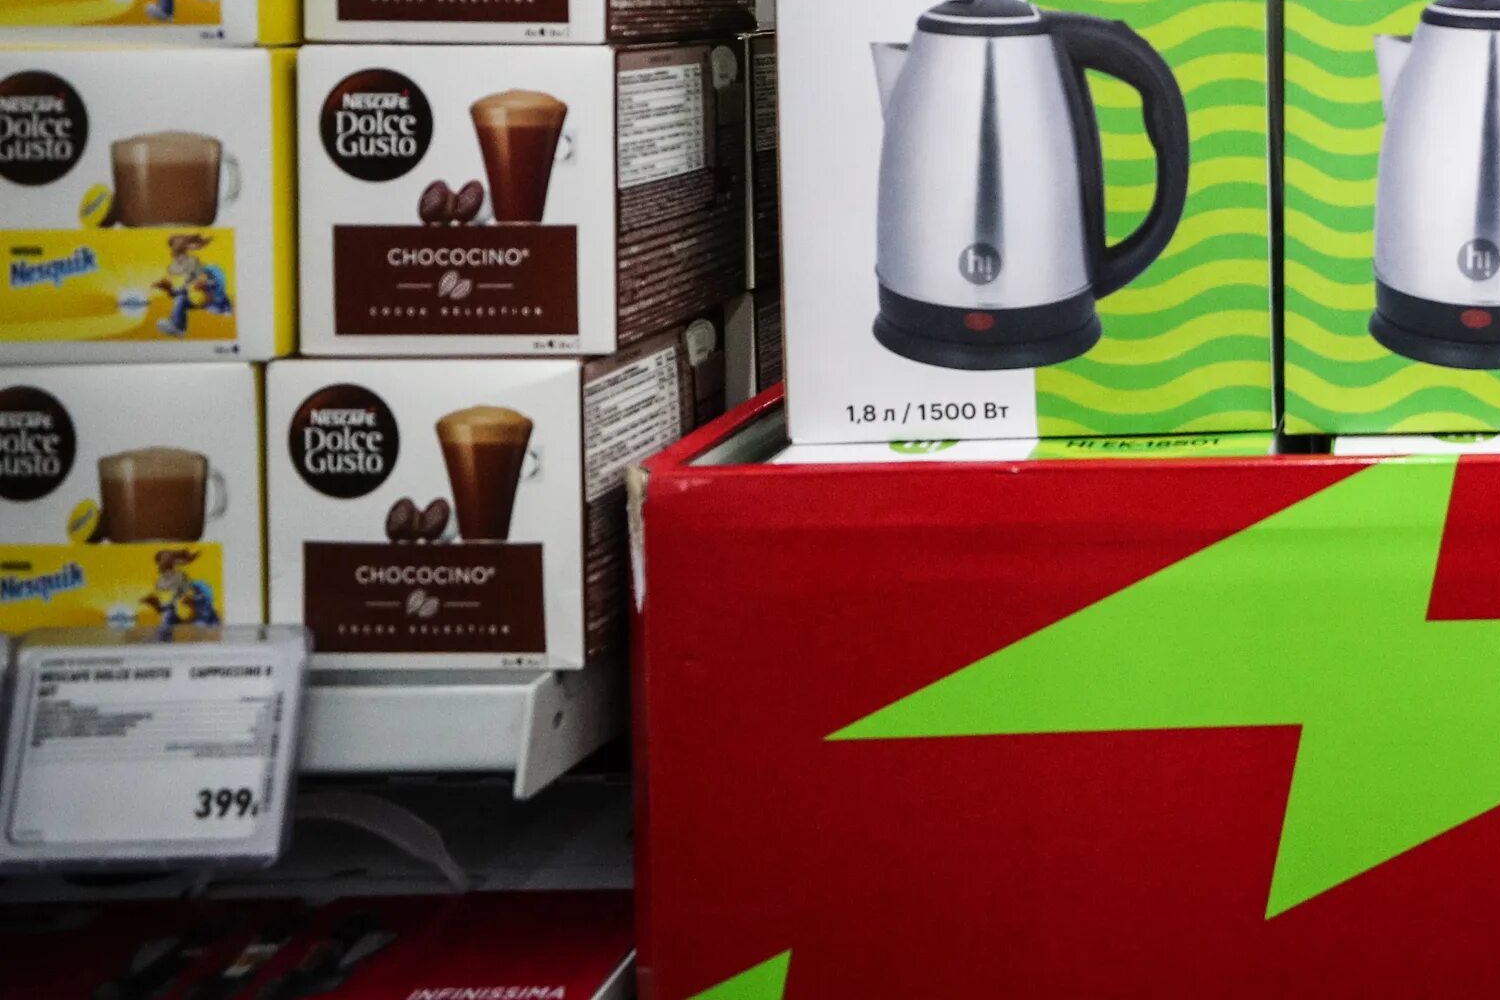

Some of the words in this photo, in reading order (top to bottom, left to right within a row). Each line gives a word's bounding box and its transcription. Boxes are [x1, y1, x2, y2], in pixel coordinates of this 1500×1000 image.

[335, 110, 418, 137] Dolce
[336, 133, 418, 158] Gusto
[847, 405, 876, 424] 1,8
[883, 409, 896, 421] л
[917, 403, 977, 421] 1500
[984, 403, 1010, 420] Вт
[0, 428, 61, 450] olce
[305, 427, 384, 452] Dolce
[0, 452, 61, 476] usto
[305, 449, 384, 474] Gusto
